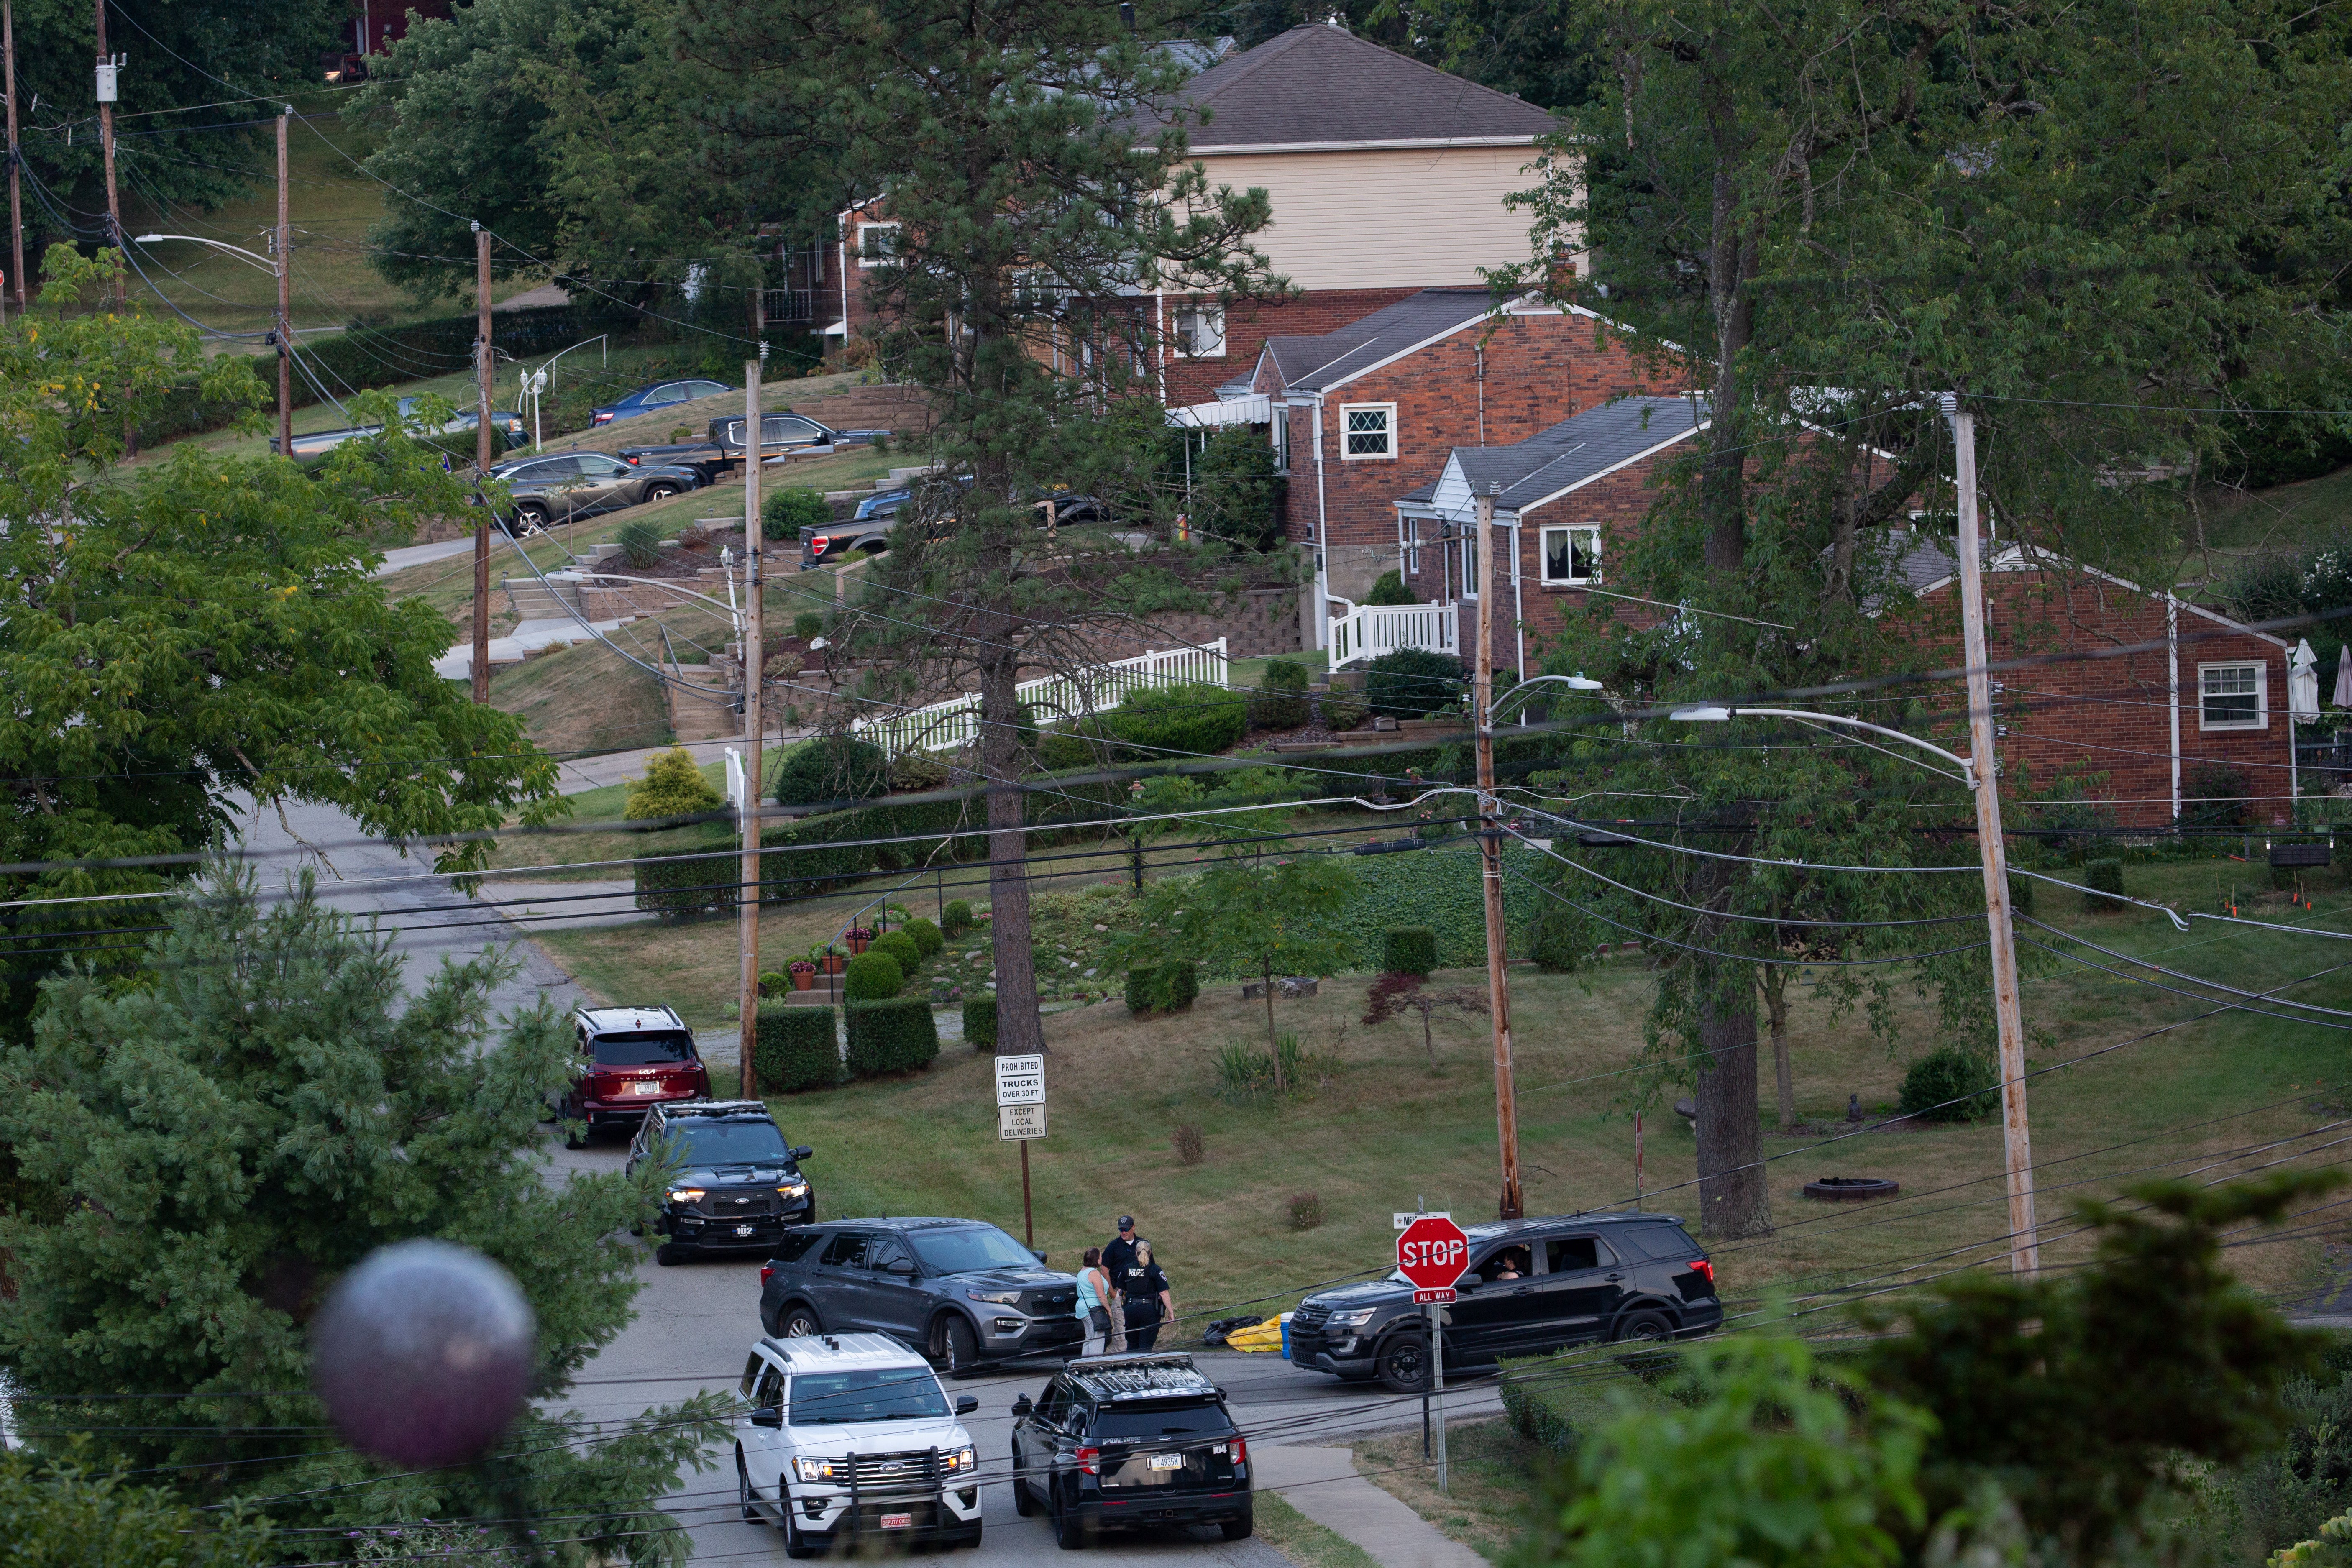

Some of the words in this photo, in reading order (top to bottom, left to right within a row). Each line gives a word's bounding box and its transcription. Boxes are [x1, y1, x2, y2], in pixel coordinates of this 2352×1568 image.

[1002, 1062, 1038, 1071] PROHIBITED
[1004, 1127, 1042, 1136] DELIVERIES
[1403, 1239, 1464, 1267] STOP
[1419, 1292, 1432, 1302] ALL
[1137, 1388, 1192, 1397] 104
[1103, 1436, 1141, 1445] POLICE
[1213, 1443, 1227, 1454] 104
[1161, 1458, 1178, 1466] 4935M
